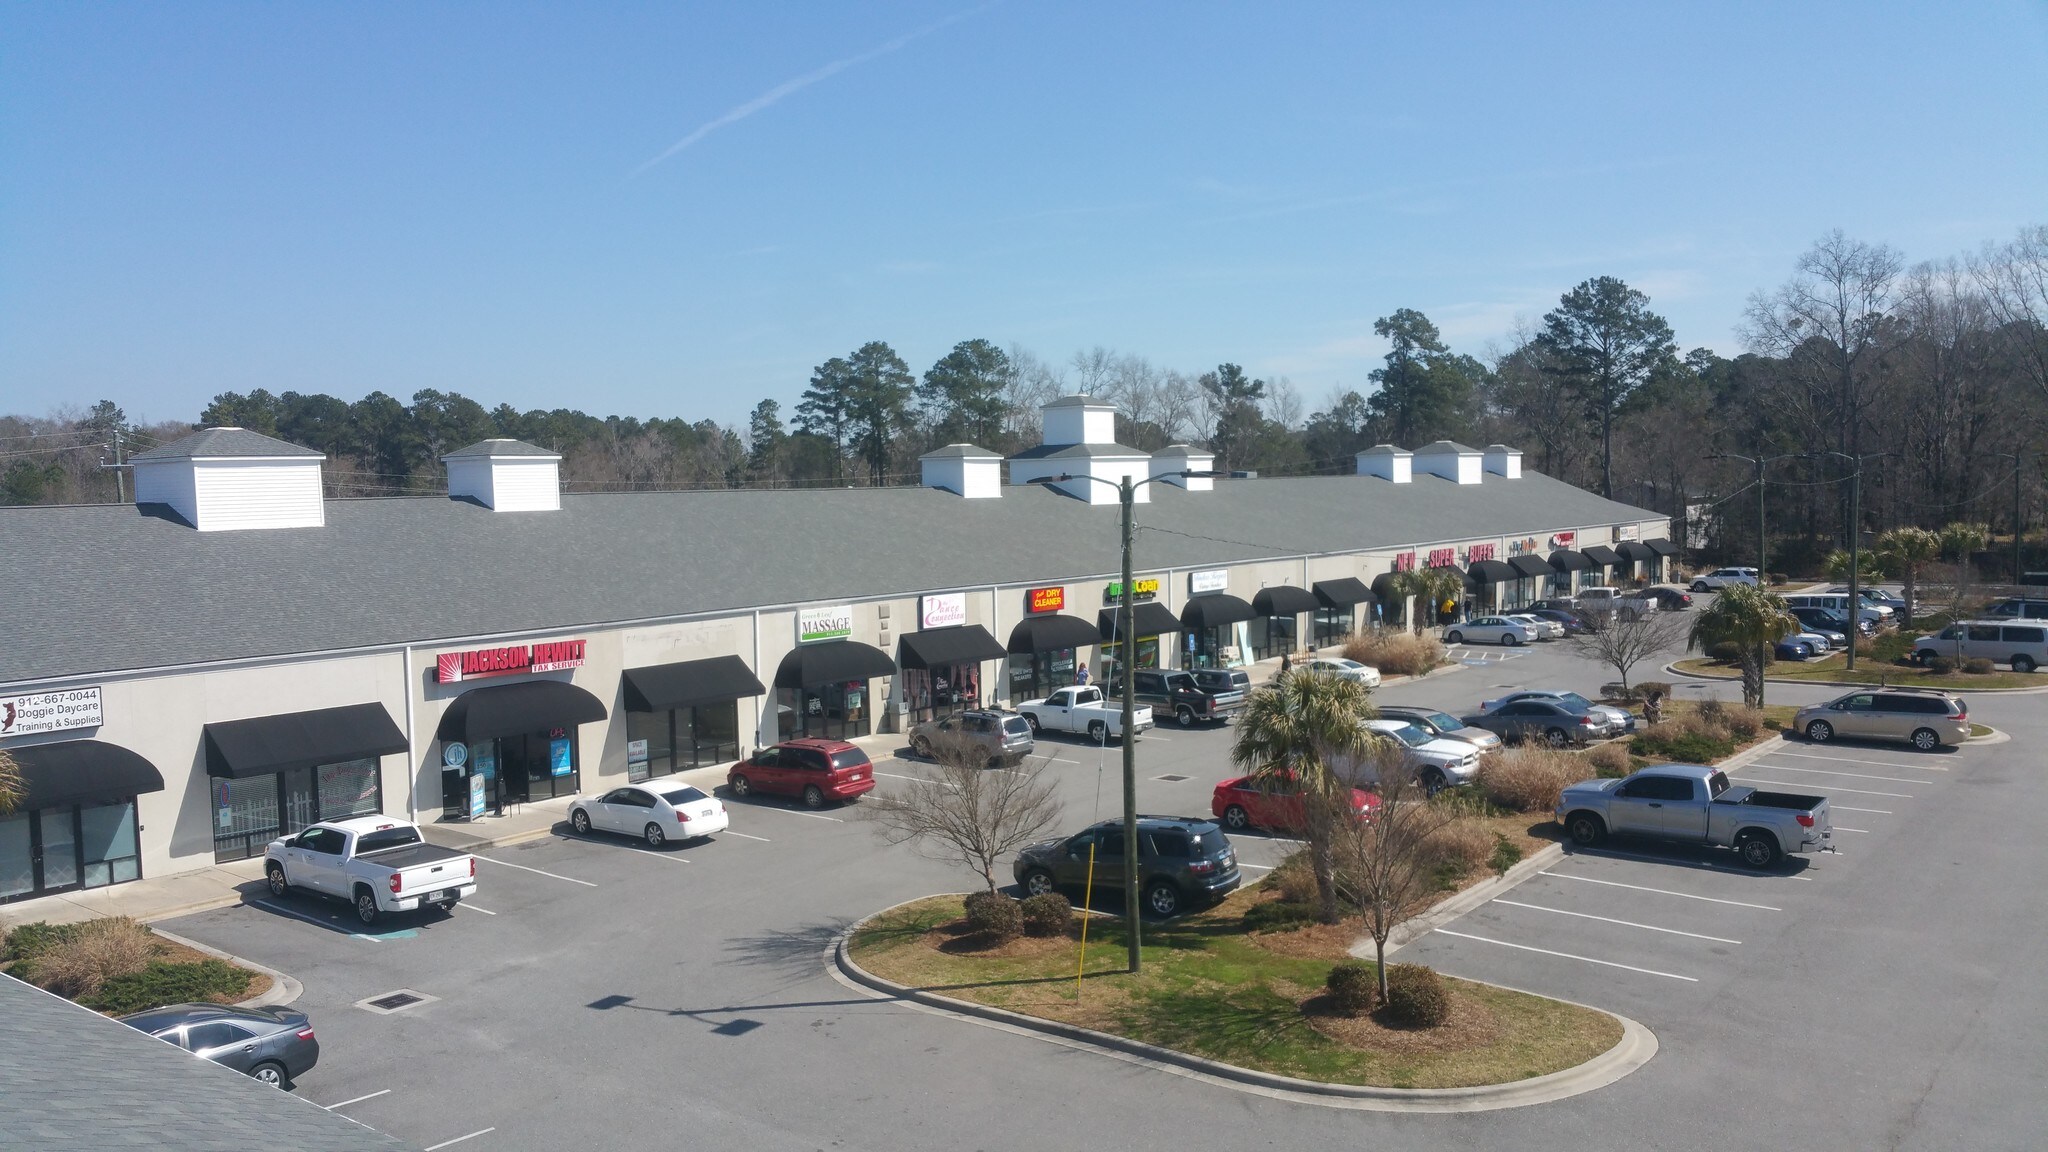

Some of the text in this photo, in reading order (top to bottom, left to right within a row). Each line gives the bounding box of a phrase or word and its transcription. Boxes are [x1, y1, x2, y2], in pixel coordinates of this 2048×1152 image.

[1397, 552, 1416, 572] NEW
[1429, 548, 1455, 568] SUPER
[1468, 543, 1496, 563] BUFFET
[1046, 588, 1061, 598] DRY
[926, 597, 960, 613] Dance
[1034, 597, 1062, 608] CLEANER
[802, 617, 850, 634] MASSAGE
[462, 639, 587, 674] JACKSON HEWITT
[533, 659, 585, 673] TAX SERVICE
[18, 690, 97, 707] 912-667-0044
[17, 702, 99, 719] Doggie Daycare
[16, 715, 101, 732] Training & Supplies
